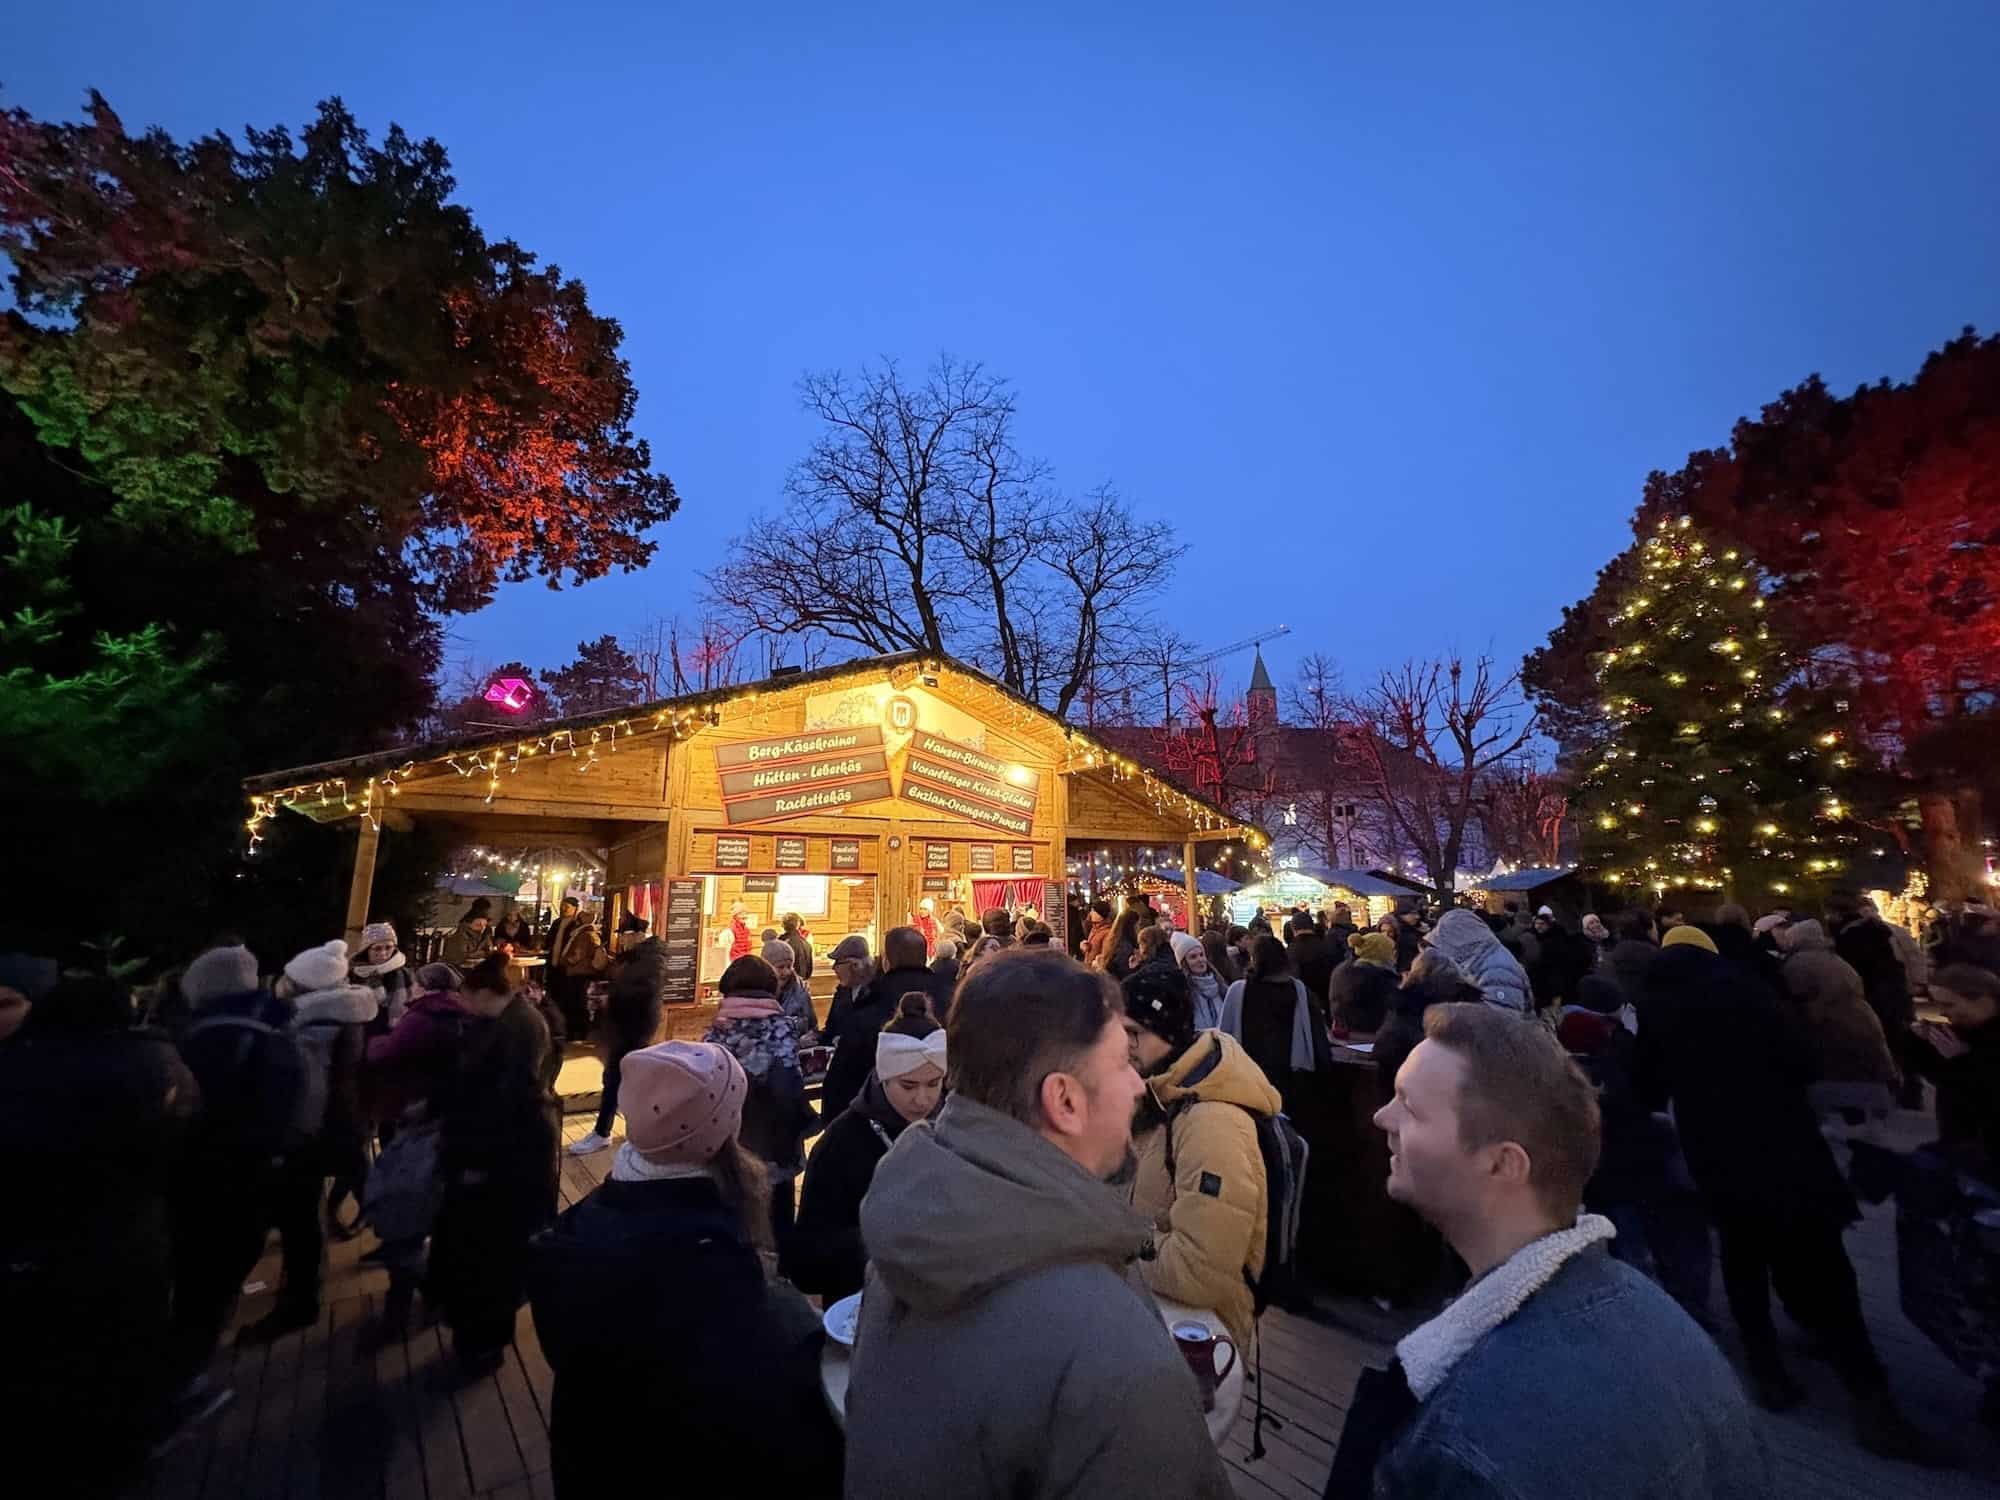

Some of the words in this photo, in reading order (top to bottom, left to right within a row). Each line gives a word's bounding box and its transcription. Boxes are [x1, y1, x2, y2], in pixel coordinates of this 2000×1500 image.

[748, 735, 857, 760] Berg-Käsekrainer
[753, 770, 800, 787] Hütten
[810, 760, 862, 779] Leberkäs
[912, 761, 971, 788] Vorarlberger
[972, 781, 1031, 808] Kirsch-Glüher
[775, 789, 852, 813] Raclettekäs
[908, 786, 1027, 832] Enzian-Orangen-Punsch
